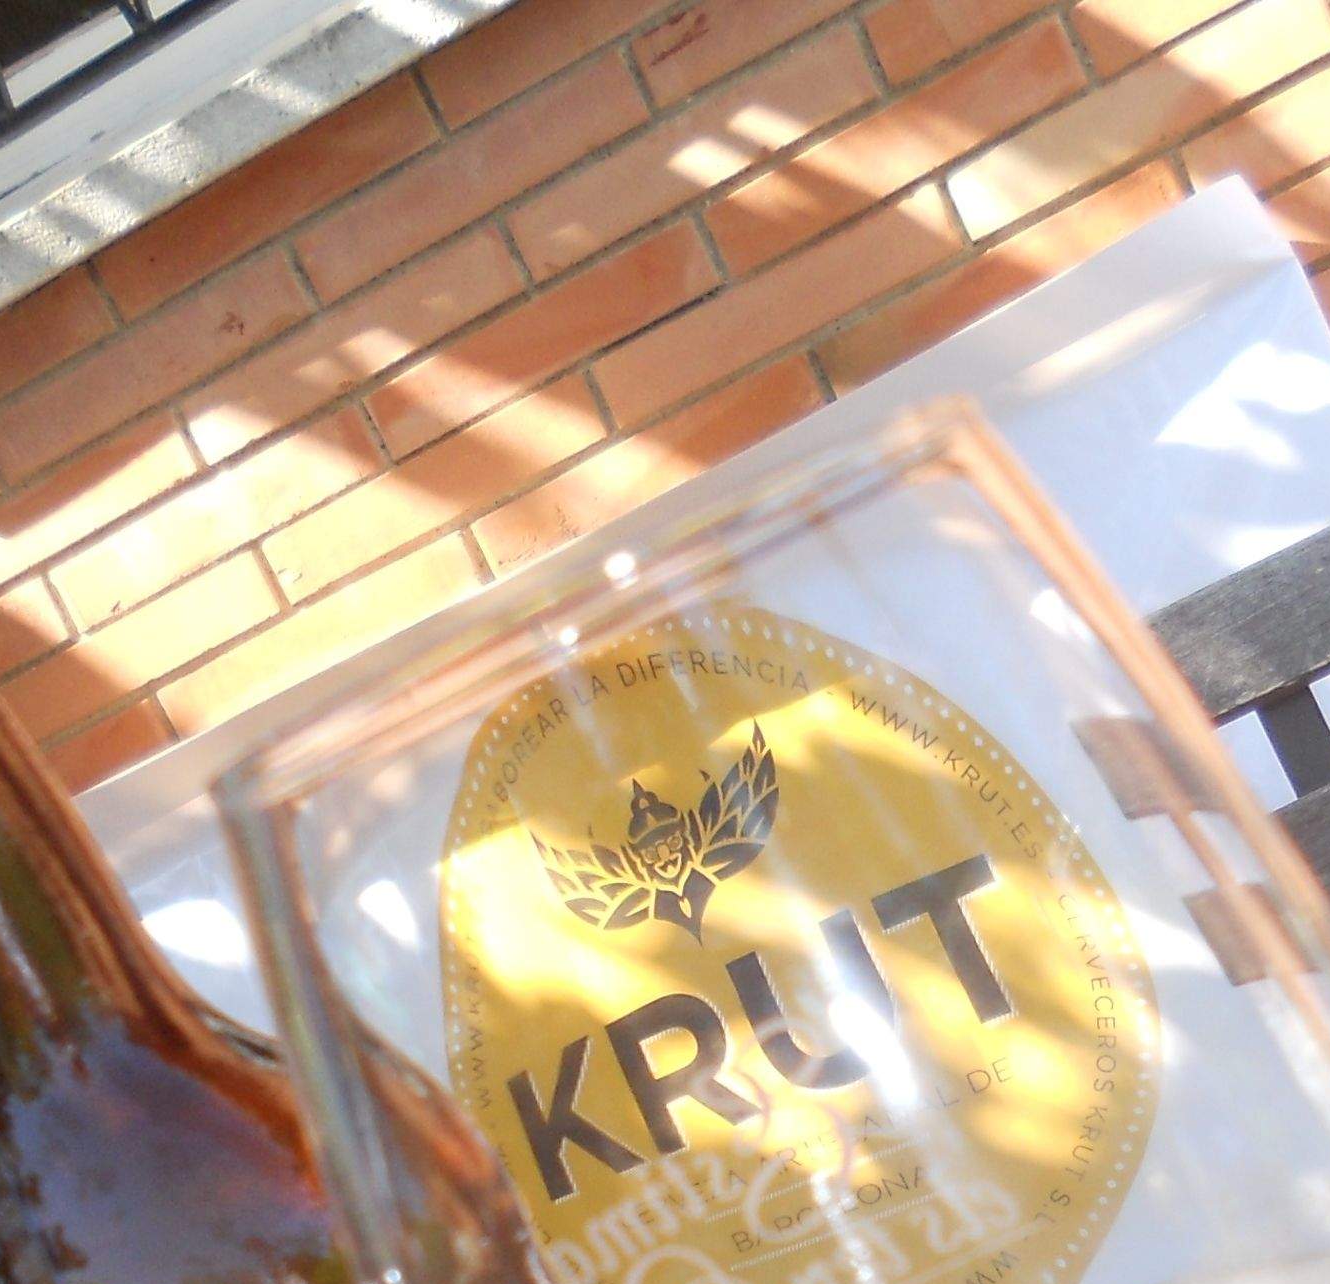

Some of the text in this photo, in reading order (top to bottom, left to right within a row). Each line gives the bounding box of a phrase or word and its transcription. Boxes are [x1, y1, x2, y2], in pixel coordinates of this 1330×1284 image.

[574, 674, 610, 707] LA
[615, 649, 810, 693] DIFERENCIA
[850, 690, 1045, 861] WWW.KRUT.ES
[506, 853, 1014, 1203] KRUT
[965, 1057, 1012, 1095] DE
[1065, 1106, 1108, 1182] KRUT
